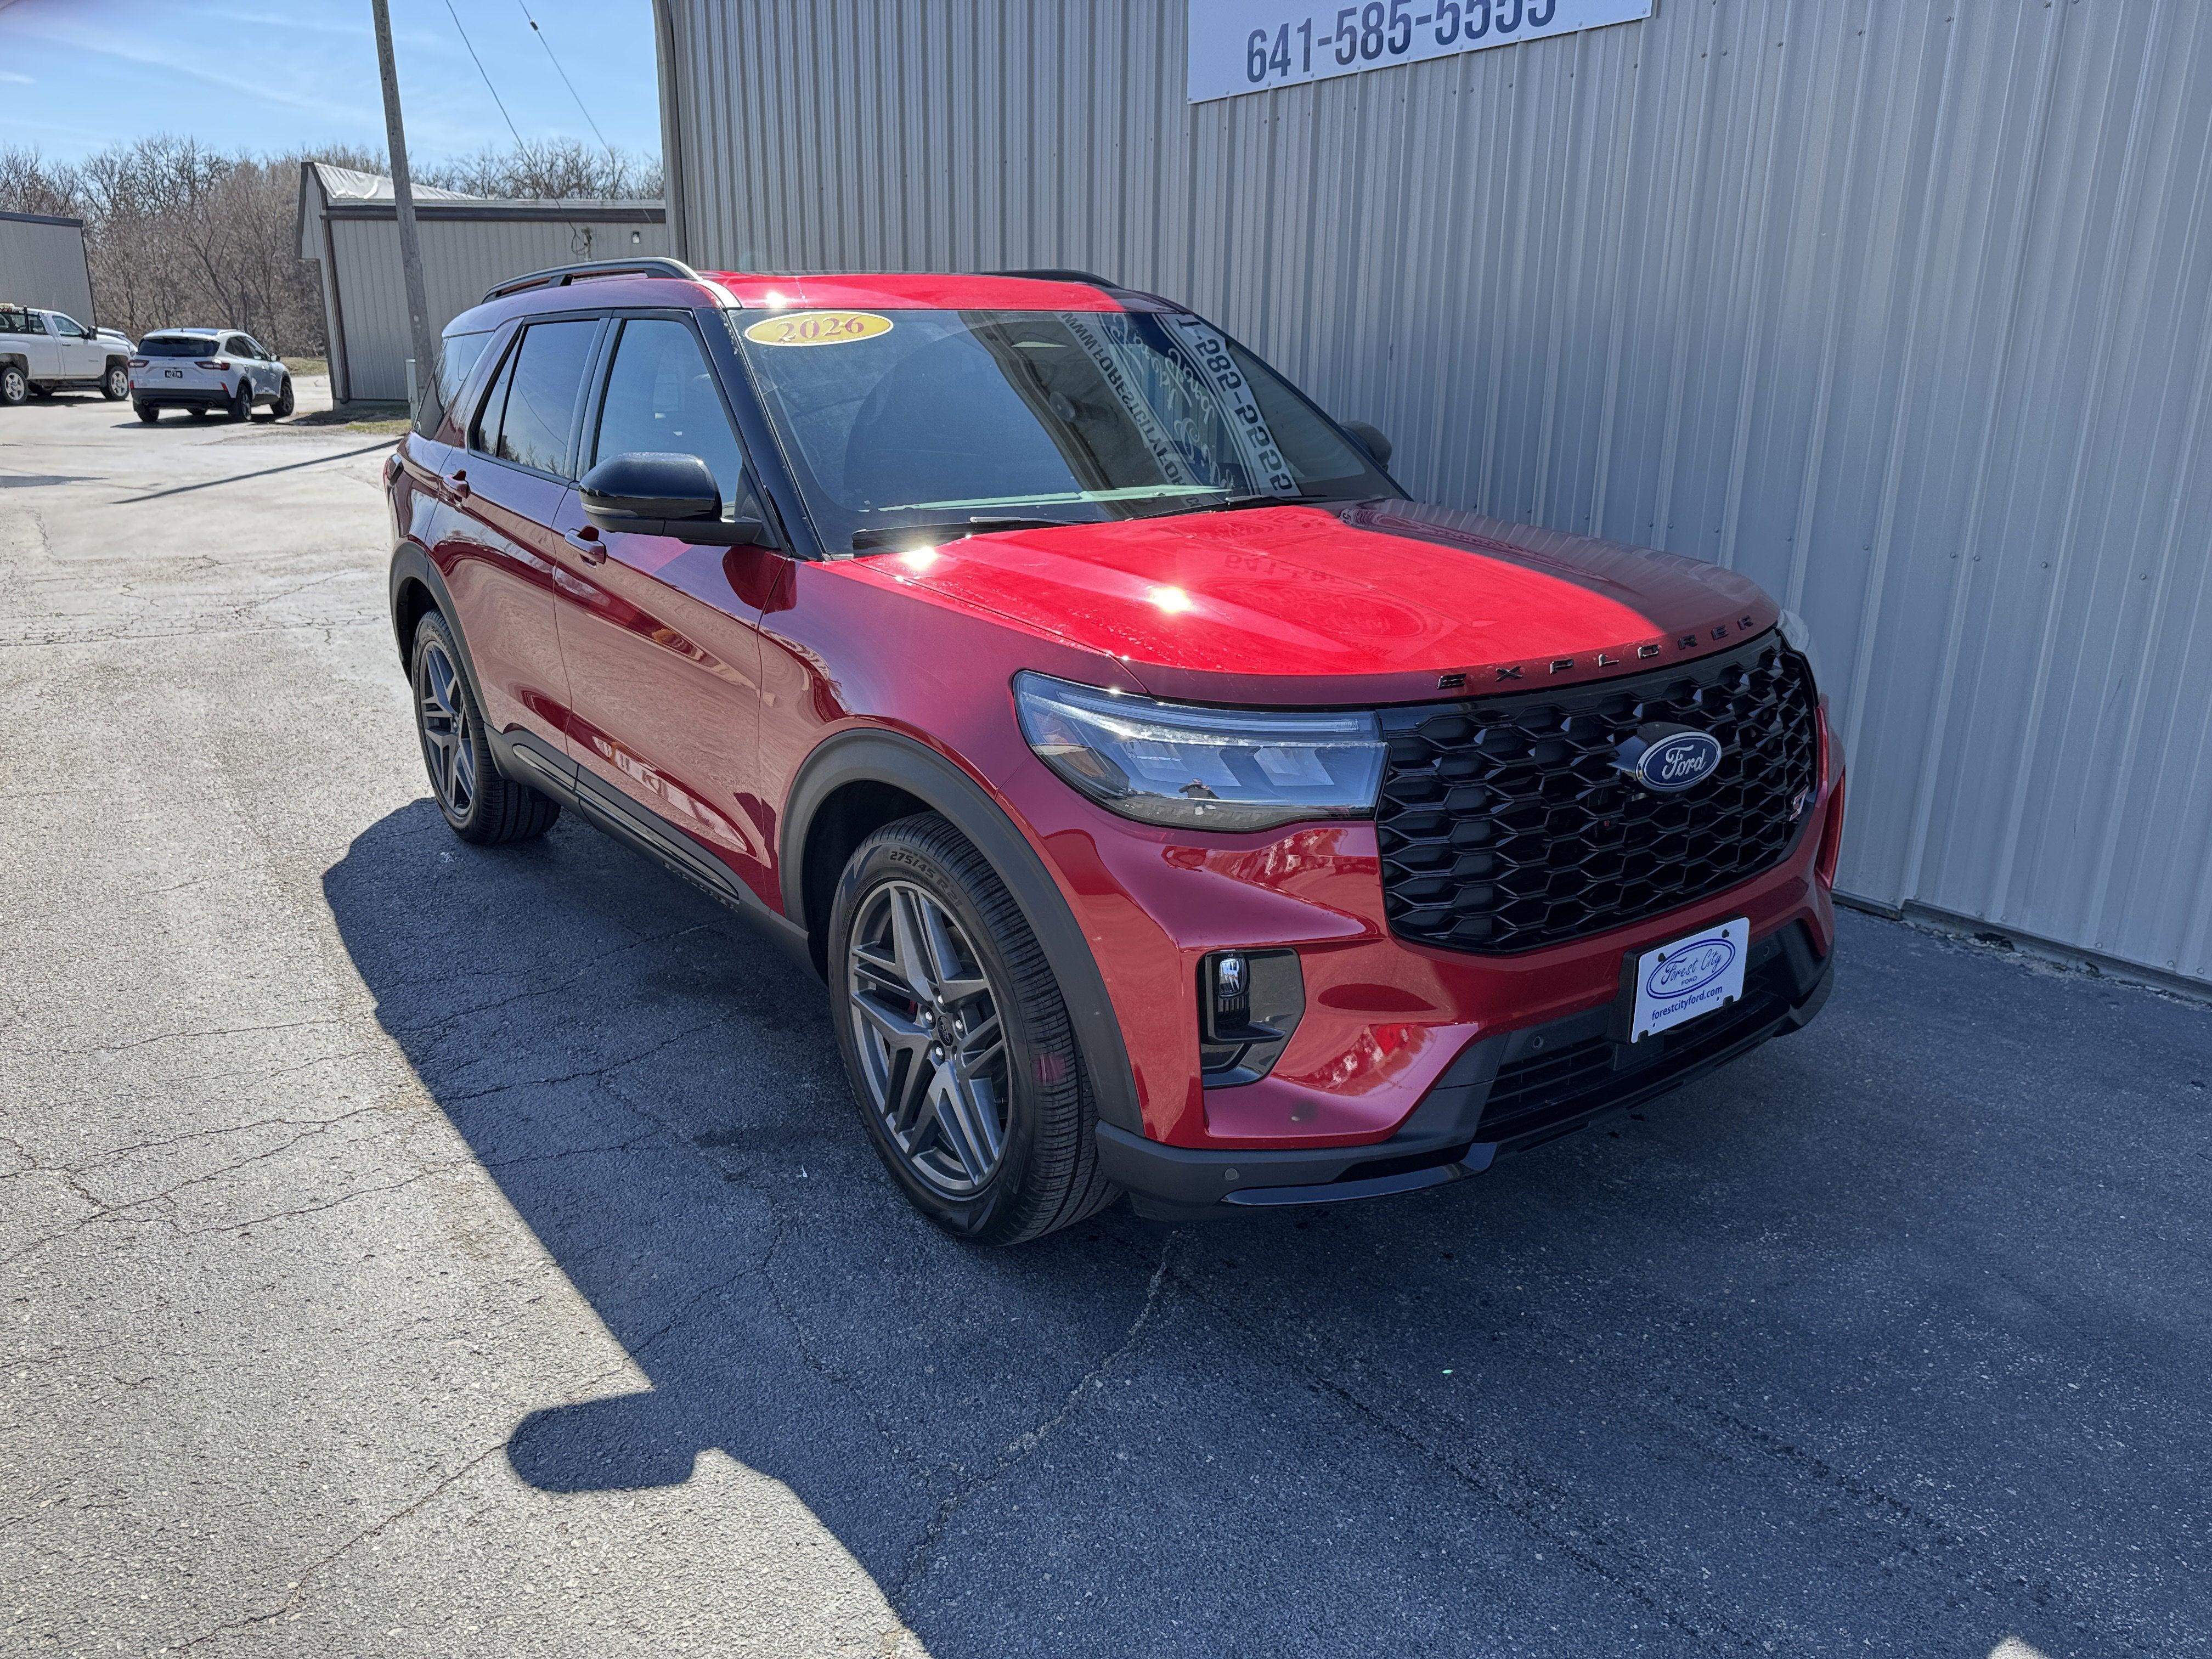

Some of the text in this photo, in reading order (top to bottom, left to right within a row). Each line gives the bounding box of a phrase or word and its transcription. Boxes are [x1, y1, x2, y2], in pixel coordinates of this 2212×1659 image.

[776, 315, 865, 342] 2026
[1437, 614, 1754, 690] EXPLORER
[1661, 744, 1706, 780] Ford
[889, 851, 936, 878] 275/45
[1661, 948, 1723, 985] Forest City
[1680, 975, 1697, 986] FORD
[1651, 986, 1723, 1020] forestcityford.com
